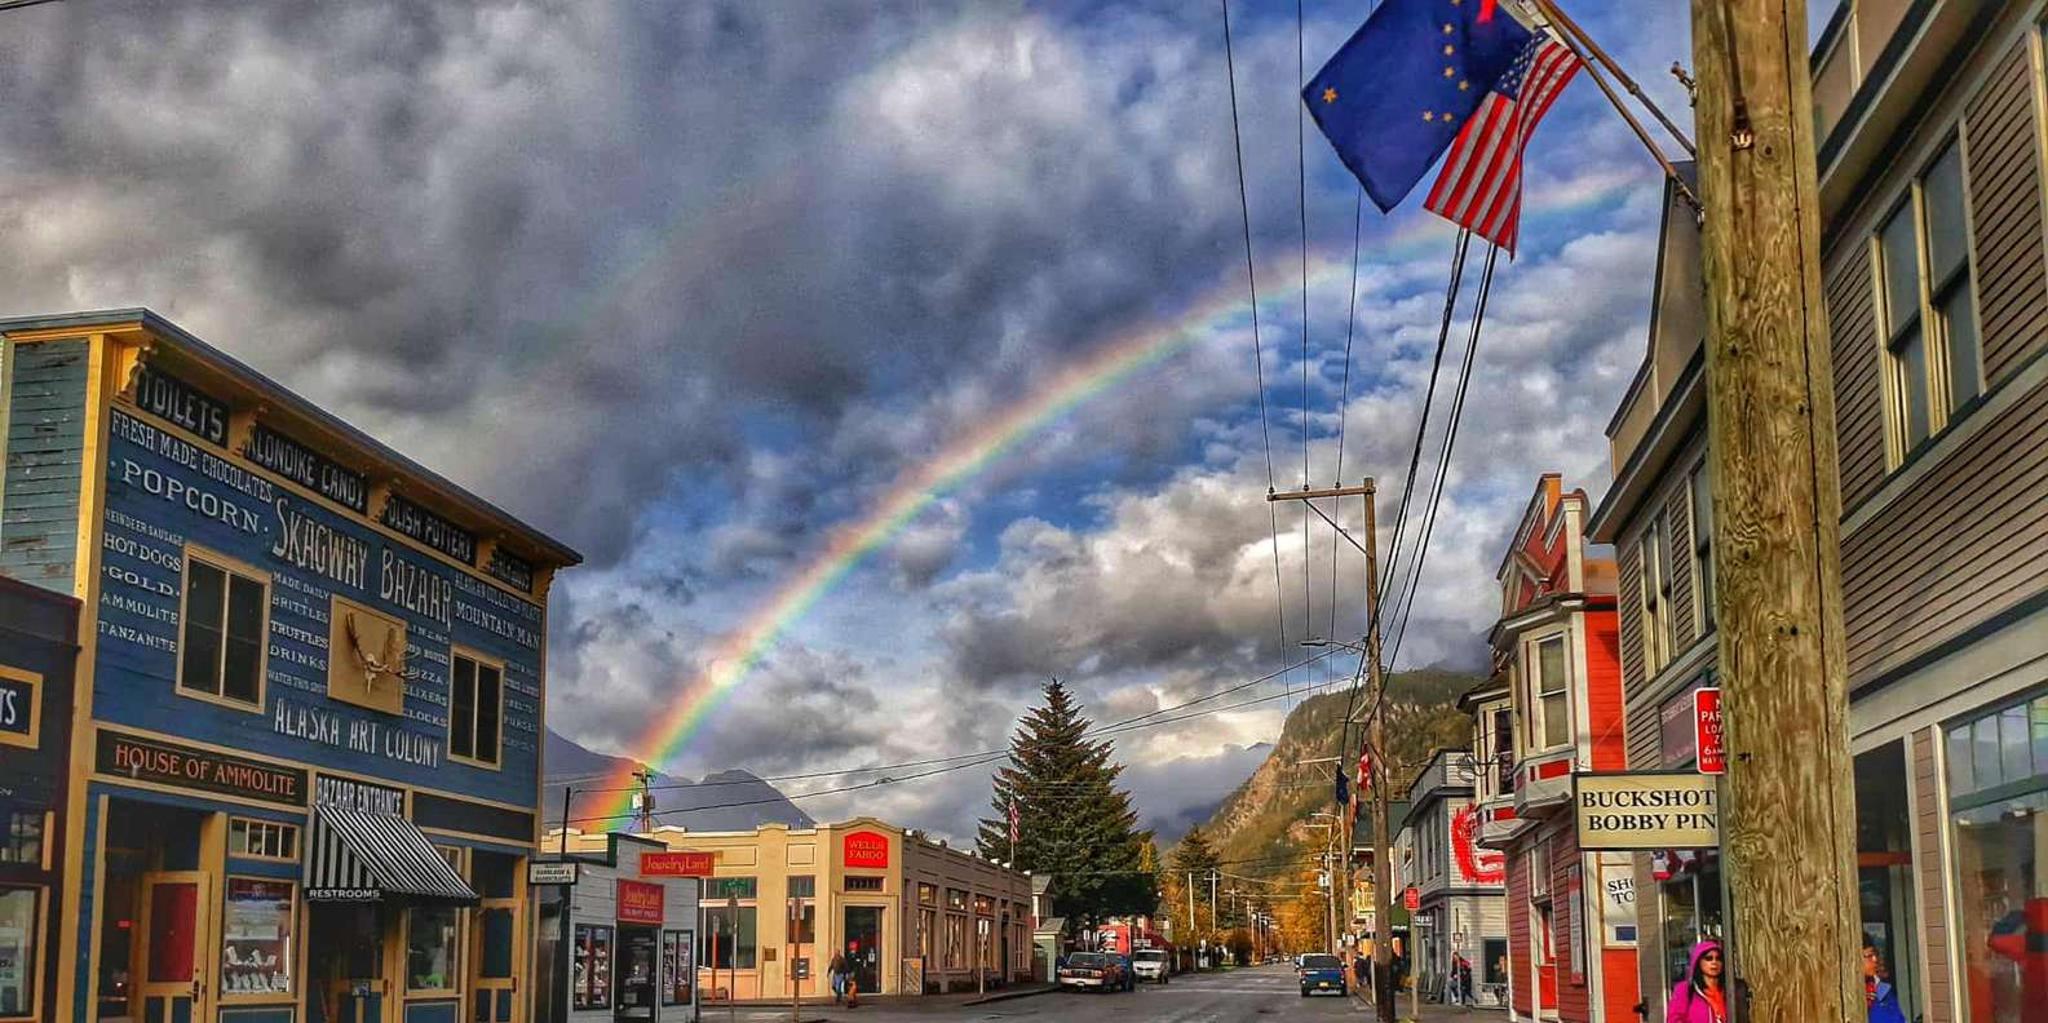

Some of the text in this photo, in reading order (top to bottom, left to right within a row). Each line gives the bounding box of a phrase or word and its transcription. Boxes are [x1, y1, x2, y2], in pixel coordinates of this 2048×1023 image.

[140, 369, 223, 443] TOILETS
[112, 411, 272, 503] FRESH MADE CHOCOLATES
[247, 429, 364, 508] KLONDIKE CANDY
[122, 458, 260, 533] POPCORN
[387, 497, 421, 537] OLISH
[104, 532, 182, 572] HOT DOGS
[272, 498, 368, 590] SKAGWAY
[380, 548, 452, 632] BAZAAR
[273, 570, 300, 590] MADE
[101, 592, 178, 625] AMMOLITE
[272, 594, 329, 624] BRITTLES
[456, 601, 515, 638] MOUNTAIN
[98, 621, 177, 653] TANZANITE
[270, 621, 329, 649] TRUFFLES
[270, 645, 327, 671] DRINKS
[274, 697, 440, 768] ALASKA ART COLONY
[115, 744, 296, 796] HOUSE OF AMMOLITE
[316, 777, 402, 817] BAZAAR ENTRANCE
[1582, 790, 1715, 807] BUCKSHOT
[1588, 814, 1716, 830] BOBBY PIN
[848, 839, 884, 850] WELLS
[848, 850, 884, 860] FARGO
[308, 889, 381, 899] RESTROOMS
